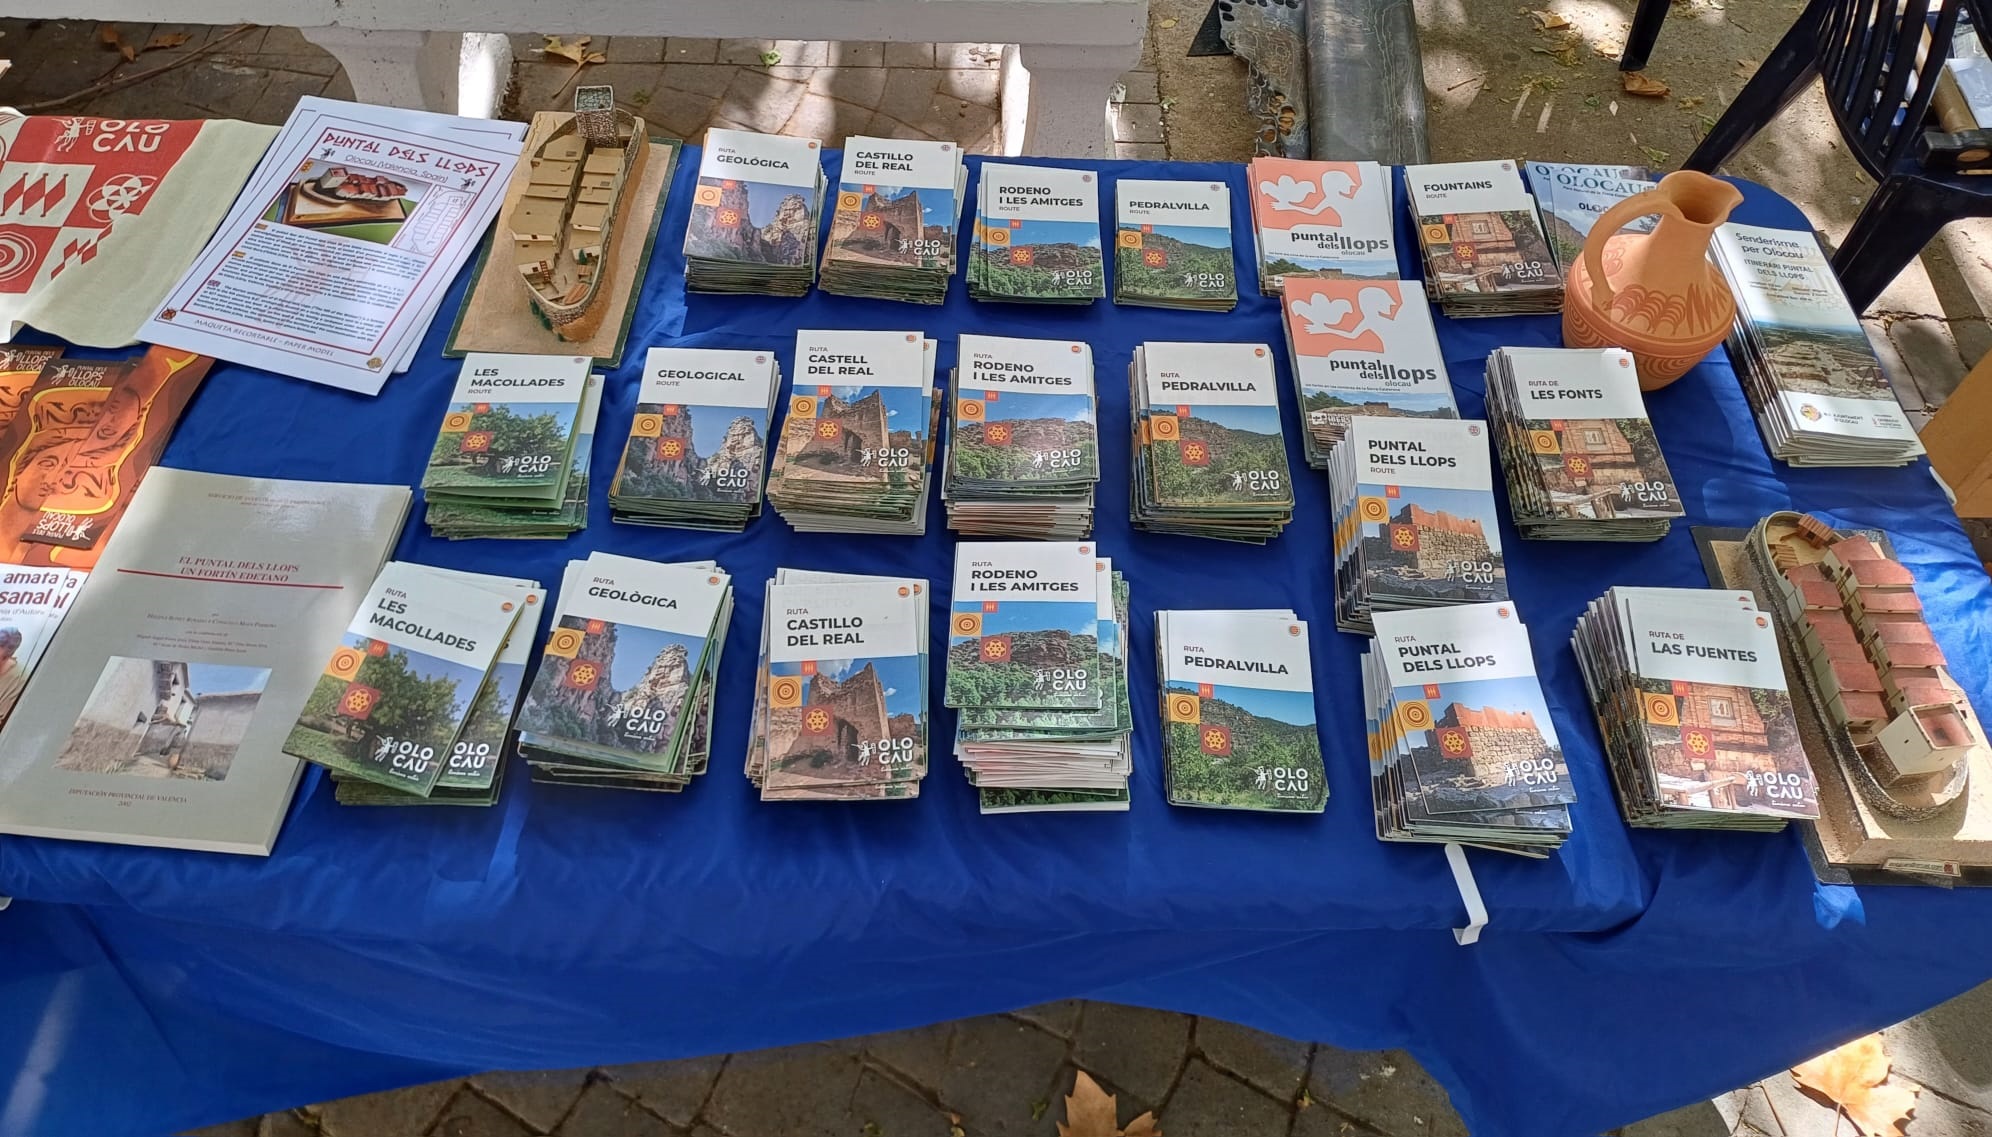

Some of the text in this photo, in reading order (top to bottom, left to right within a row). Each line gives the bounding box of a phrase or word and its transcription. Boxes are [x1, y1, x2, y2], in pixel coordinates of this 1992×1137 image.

[100, 120, 170, 134] OLO
[92, 133, 161, 152] CAU
[856, 151, 914, 161] CASTILLO
[717, 155, 789, 169] GEOLÓGICA
[855, 161, 913, 171] DEL REAL
[344, 154, 378, 168] Olocau
[420, 169, 449, 184] Spain)
[1000, 186, 1051, 196] RODENO
[1424, 181, 1493, 192] FOUNTAINS
[1006, 197, 1028, 205] LES
[1030, 197, 1083, 207] AMITGES
[1129, 200, 1210, 211] PEDRALVILLA
[1291, 231, 1338, 243] puntal
[1736, 233, 1799, 248] Senderisme
[914, 239, 941, 248] OLO
[1317, 241, 1339, 249] dels
[1341, 236, 1389, 253] llops
[914, 247, 939, 256] CAU
[1742, 246, 1803, 258] per Olocau
[1514, 261, 1541, 271] OLO
[1783, 264, 1813, 273] PUNTAL
[1067, 270, 1093, 279] OLO
[1199, 273, 1225, 281] OLO
[1518, 269, 1543, 279] CAU
[1757, 268, 1804, 280] DELS LLOPS
[1067, 277, 1092, 286] CAU
[1200, 279, 1225, 288] CAU
[194, 319, 334, 357] MAQUETA RECORTABLE PAPER MODEL
[808, 354, 868, 364] CASTELL
[808, 366, 874, 376] DEL REAL
[973, 361, 1034, 373] RODENO
[1330, 360, 1381, 371] puntal
[71, 371, 104, 381] LLOPS
[474, 368, 499, 377] LES
[657, 369, 745, 381] GEOLOGICAL
[1360, 371, 1384, 379] dels
[1382, 364, 1437, 384] llops
[471, 378, 565, 388] MACOLLADES
[981, 373, 1006, 382] LES
[1009, 374, 1072, 386] AMITGES
[1162, 381, 1256, 392] PEDRALVILLA
[1531, 389, 1603, 400] LES FONTS
[1368, 440, 1426, 452] PUNTAL
[878, 448, 909, 458] OLO
[1050, 449, 1081, 459] OLO
[521, 455, 552, 464] OLO
[878, 457, 908, 467] CAU
[1050, 457, 1081, 468] CAU
[1370, 453, 1457, 468] DELS LLOPS
[518, 464, 549, 473] CAU
[717, 468, 748, 478] OLO
[1370, 467, 1396, 475] ROUTE
[1249, 470, 1279, 481] OLO
[716, 477, 748, 488] CAU
[1250, 479, 1280, 490] CAU
[1635, 481, 1664, 491] OLO
[1638, 491, 1667, 501] CAU
[36, 519, 71, 533] LLOPS
[179, 556, 299, 573] EL PUNTAL DELS LLOPS
[1461, 561, 1492, 572] OLO
[180, 567, 289, 582] UN FORTÍN EDETANO
[972, 570, 1037, 579] RODENO
[1462, 572, 1494, 583] CAU
[593, 577, 614, 586] RUTA
[980, 582, 1006, 591] LES
[1011, 582, 1079, 592] AMITGES
[385, 587, 407, 599] RUTA
[589, 587, 678, 609] GEOLÒGICA
[377, 598, 407, 614] LES
[787, 617, 863, 631] CASTILLO
[370, 613, 477, 652] MACOLLADES
[1649, 630, 1670, 639] RUTA
[787, 631, 864, 647] DEL REAL
[1394, 635, 1416, 644] RUTA
[1184, 645, 1204, 653] RUTA
[1398, 642, 1461, 659] PUNTAL
[1652, 642, 1758, 663] LAS FUENTES
[1184, 655, 1288, 675] PEDRALVILLA
[1403, 654, 1496, 673] DELS LLOPS
[1053, 669, 1087, 679] OLO
[1053, 680, 1086, 690] CAU
[631, 707, 666, 721] OLO
[626, 719, 661, 733] CAU
[453, 741, 490, 755] OLO
[879, 737, 913, 750] OLO
[399, 741, 434, 760] OLO
[449, 755, 486, 768] CAU
[879, 750, 913, 764] CAU
[392, 754, 428, 773] CAU
[1520, 758, 1554, 772] OLO
[1274, 767, 1308, 779] OLO
[1524, 771, 1557, 785] CAU
[1763, 771, 1801, 786] OLO
[1275, 780, 1308, 791] CAU
[1767, 786, 1803, 799] CAU
